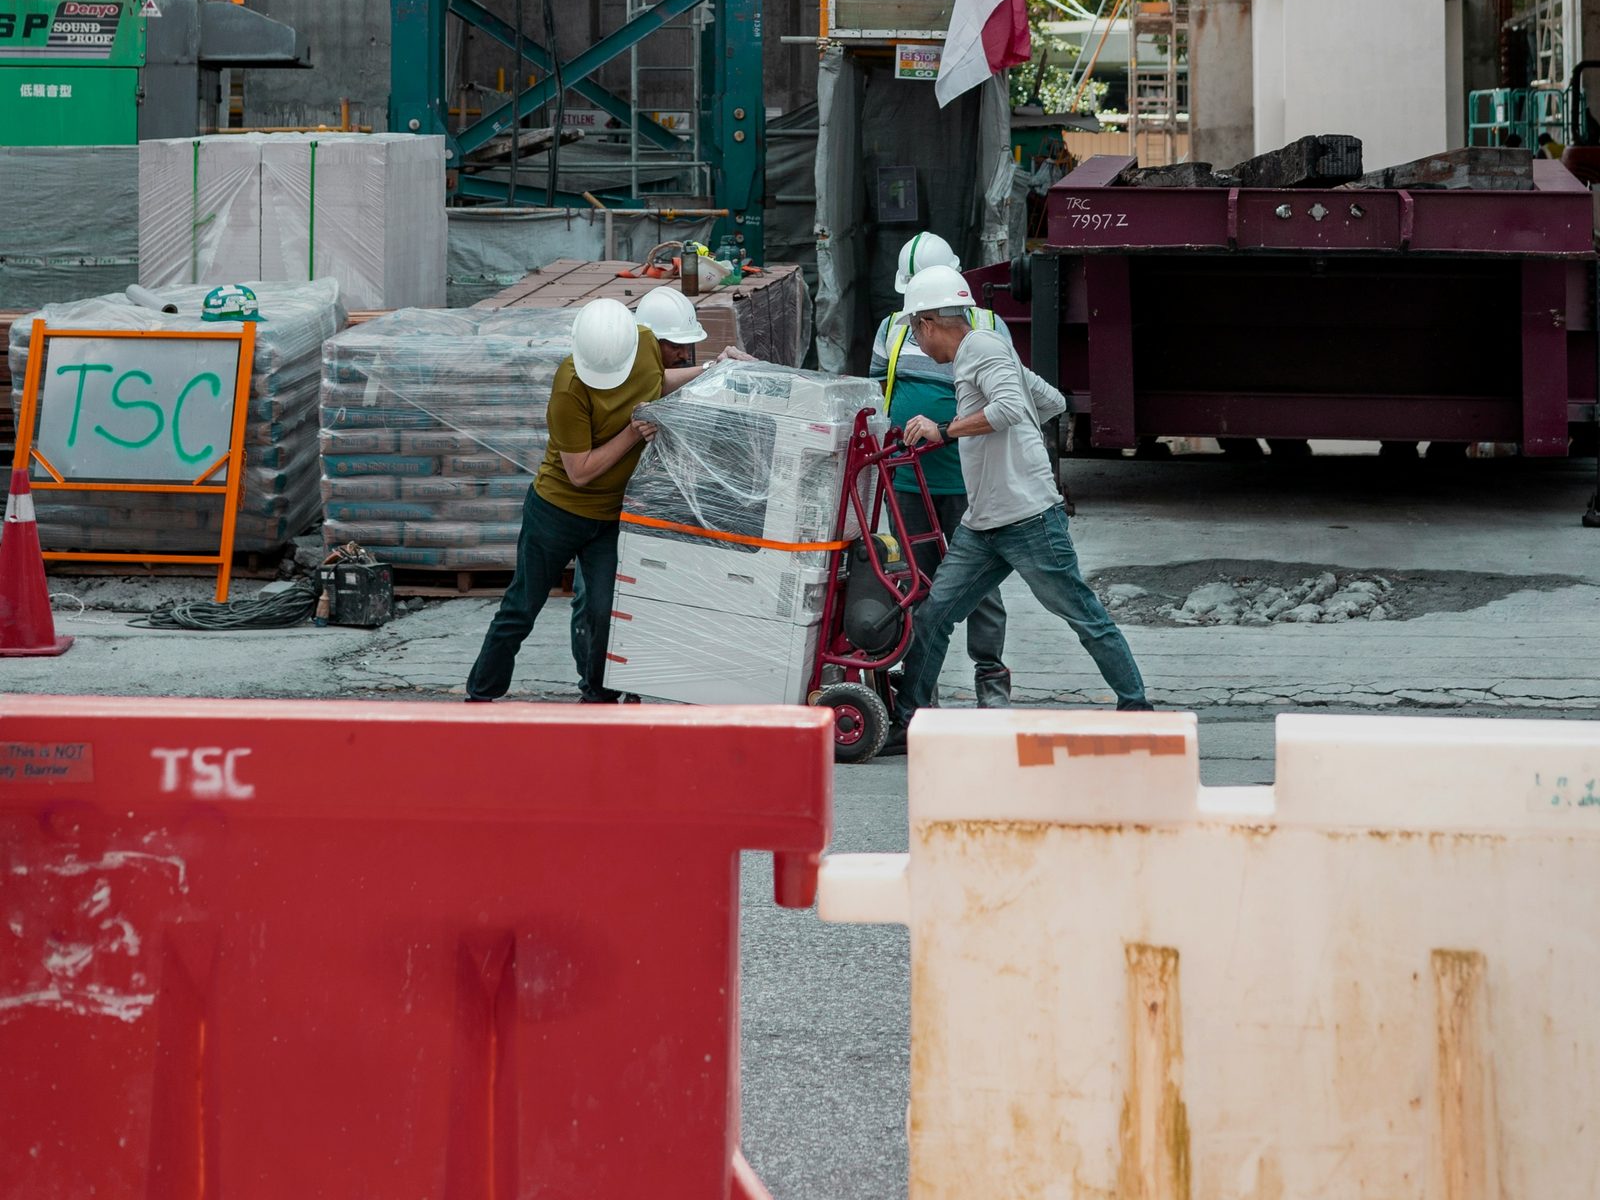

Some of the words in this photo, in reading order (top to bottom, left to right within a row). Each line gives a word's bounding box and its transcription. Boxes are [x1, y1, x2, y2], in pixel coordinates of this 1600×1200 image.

[64, 2, 119, 18] Denyo
[53, 22, 101, 33] SOUND
[66, 33, 114, 44] PROOF
[914, 52, 937, 62] STOP
[915, 70, 934, 78] GO
[1066, 197, 1091, 210] TRC
[57, 363, 221, 464] TSC
[55, 744, 84, 759] NOT
[24, 764, 70, 776] Barrier
[150, 747, 255, 799] TSC
